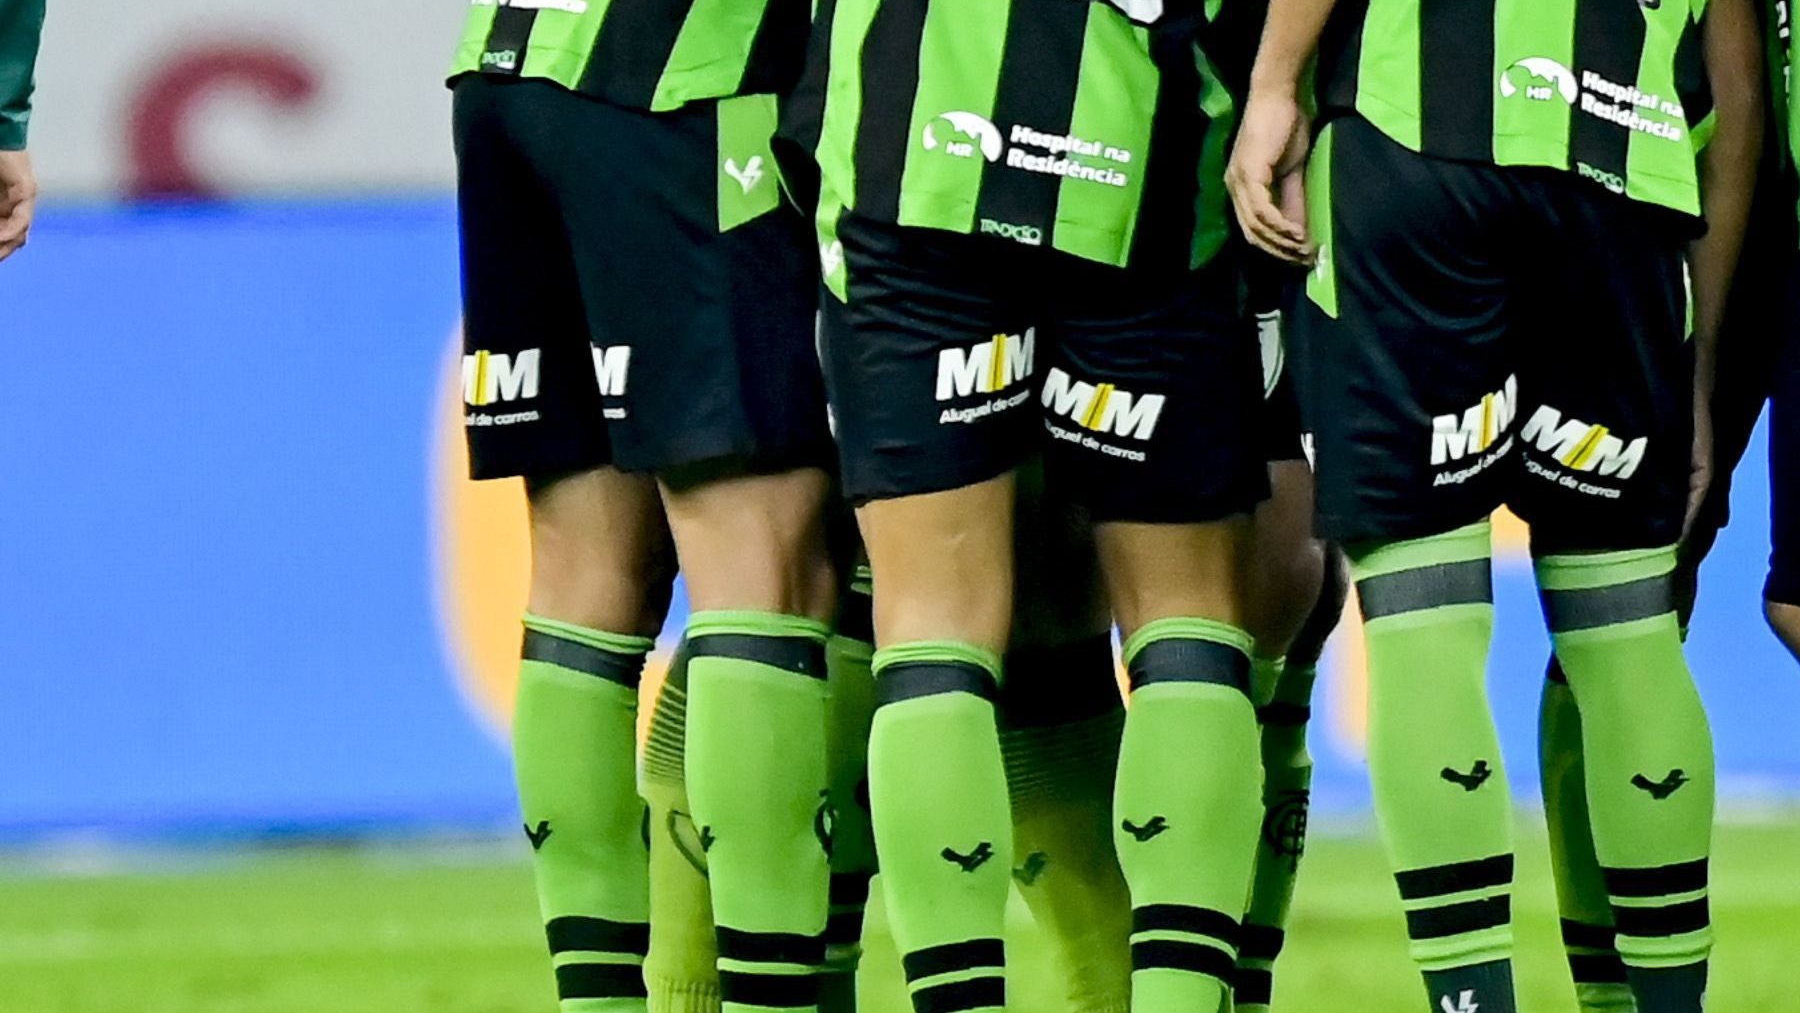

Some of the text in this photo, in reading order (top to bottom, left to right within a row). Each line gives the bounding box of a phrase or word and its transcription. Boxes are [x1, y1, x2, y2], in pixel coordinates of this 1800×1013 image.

[1582, 70, 1684, 118] Hospital na
[1580, 92, 1682, 141] Residência
[1010, 124, 1131, 164] Hospital na
[1006, 148, 1128, 187] Residência
[939, 400, 991, 425] Aluguel
[1082, 436, 1099, 452] de
[1101, 443, 1146, 462] carros
[1433, 458, 1481, 487] Aluguel
[1558, 474, 1578, 489] de
[1578, 481, 1621, 499] carros
